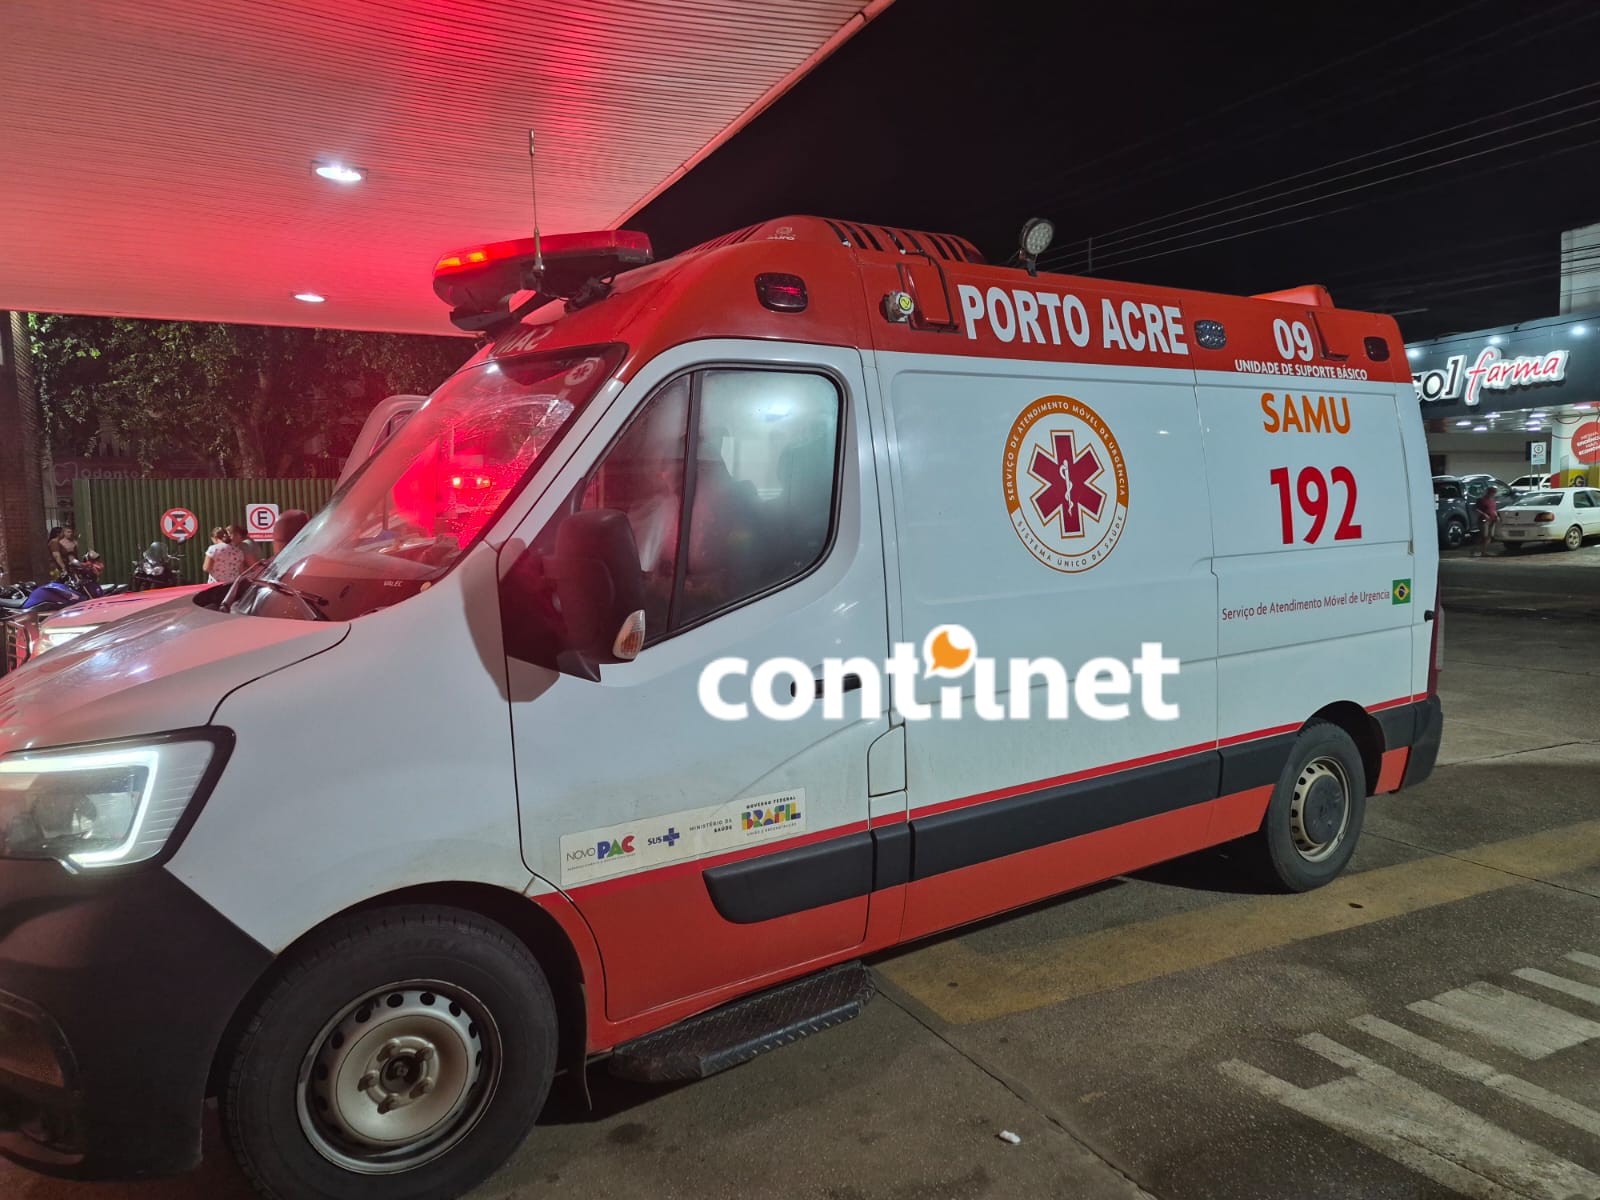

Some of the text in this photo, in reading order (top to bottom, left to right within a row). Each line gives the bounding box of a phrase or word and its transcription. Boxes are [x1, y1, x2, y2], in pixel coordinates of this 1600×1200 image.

[957, 284, 1190, 355] PORTO ACRE
[1273, 318, 1314, 362] 09
[1234, 359, 1368, 381] UNIDADE DE SUPORTE BÁSICO
[1466, 348, 1568, 405] farma
[1017, 401, 1069, 434] ATENDIMENTO
[1072, 404, 1098, 428] MÓVEL
[1260, 391, 1351, 435] SAMU
[1010, 435, 1019, 449] DE
[1099, 427, 1110, 441] DE
[1006, 453, 1015, 501] SERVIÇO
[257, 510, 269, 526] E
[1269, 465, 1363, 545] 192
[1017, 520, 1052, 562] SISTEMA
[1091, 550, 1102, 561] DE
[1104, 515, 1123, 550] SAÚDE
[1222, 606, 1255, 621] Serviço
[1256, 602, 1268, 616] de
[1269, 598, 1322, 614] Atendimento
[1323, 595, 1348, 607] Móvel
[1349, 591, 1359, 604] de
[746, 796, 797, 809] GOVERNO FEDERAL
[566, 835, 636, 861] NOVO PAC
[647, 836, 662, 846] SUS
